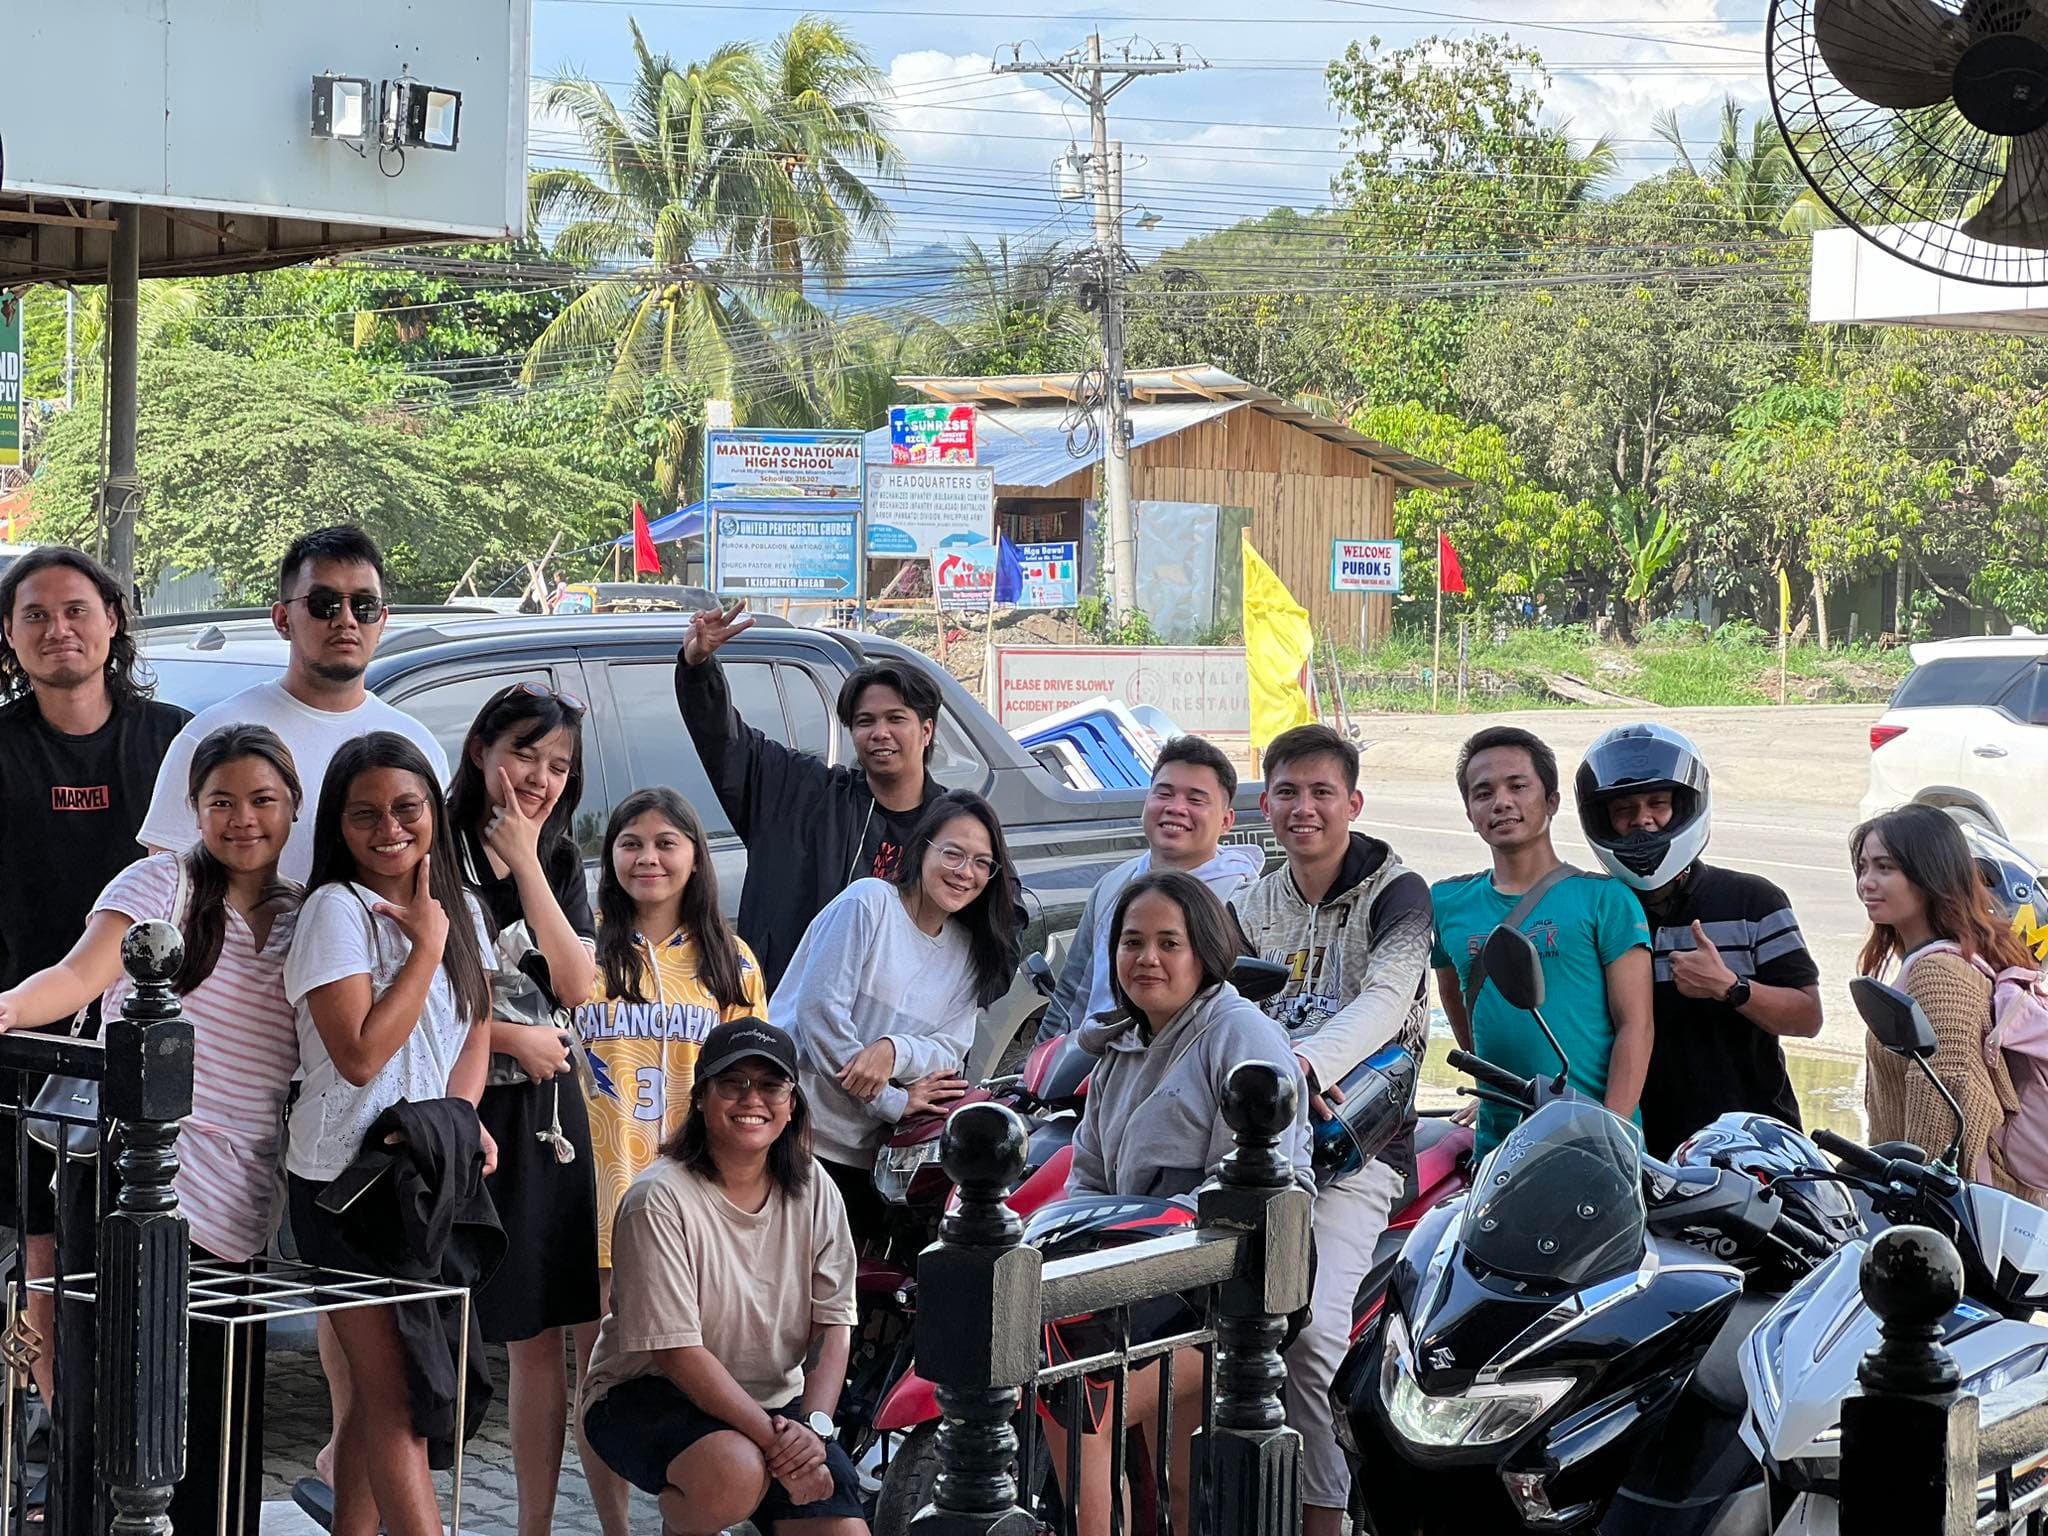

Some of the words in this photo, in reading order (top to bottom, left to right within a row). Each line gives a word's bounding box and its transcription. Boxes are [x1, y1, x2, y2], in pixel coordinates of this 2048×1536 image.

[717, 445, 791, 457] MANTICAO
[794, 446, 860, 458] NATIONAL
[745, 457, 778, 468] HIGH
[781, 458, 834, 469] SCHOOL
[889, 476, 972, 489] HEADQUARTERS
[741, 522, 767, 536] UNITED
[769, 522, 819, 536] PENTECOSTAL
[820, 523, 852, 536] CHURCH
[1042, 545, 1064, 555] Bawal
[1343, 545, 1392, 559] WELCOME
[1342, 561, 1381, 576] PUROK
[1383, 562, 1391, 576] 5
[745, 579, 749, 588] 1
[751, 578, 797, 588] KILOMETER
[797, 579, 825, 587] AHEAD
[1172, 671, 1230, 685] ROYAL
[1004, 679, 1041, 692] PLEASE
[1043, 679, 1074, 692] DRIVE
[1076, 680, 1115, 692] SLOWLY
[1005, 700, 1054, 712] ACCIDENT
[53, 786, 107, 808] MARVEL
[632, 1066, 667, 1121] 3
